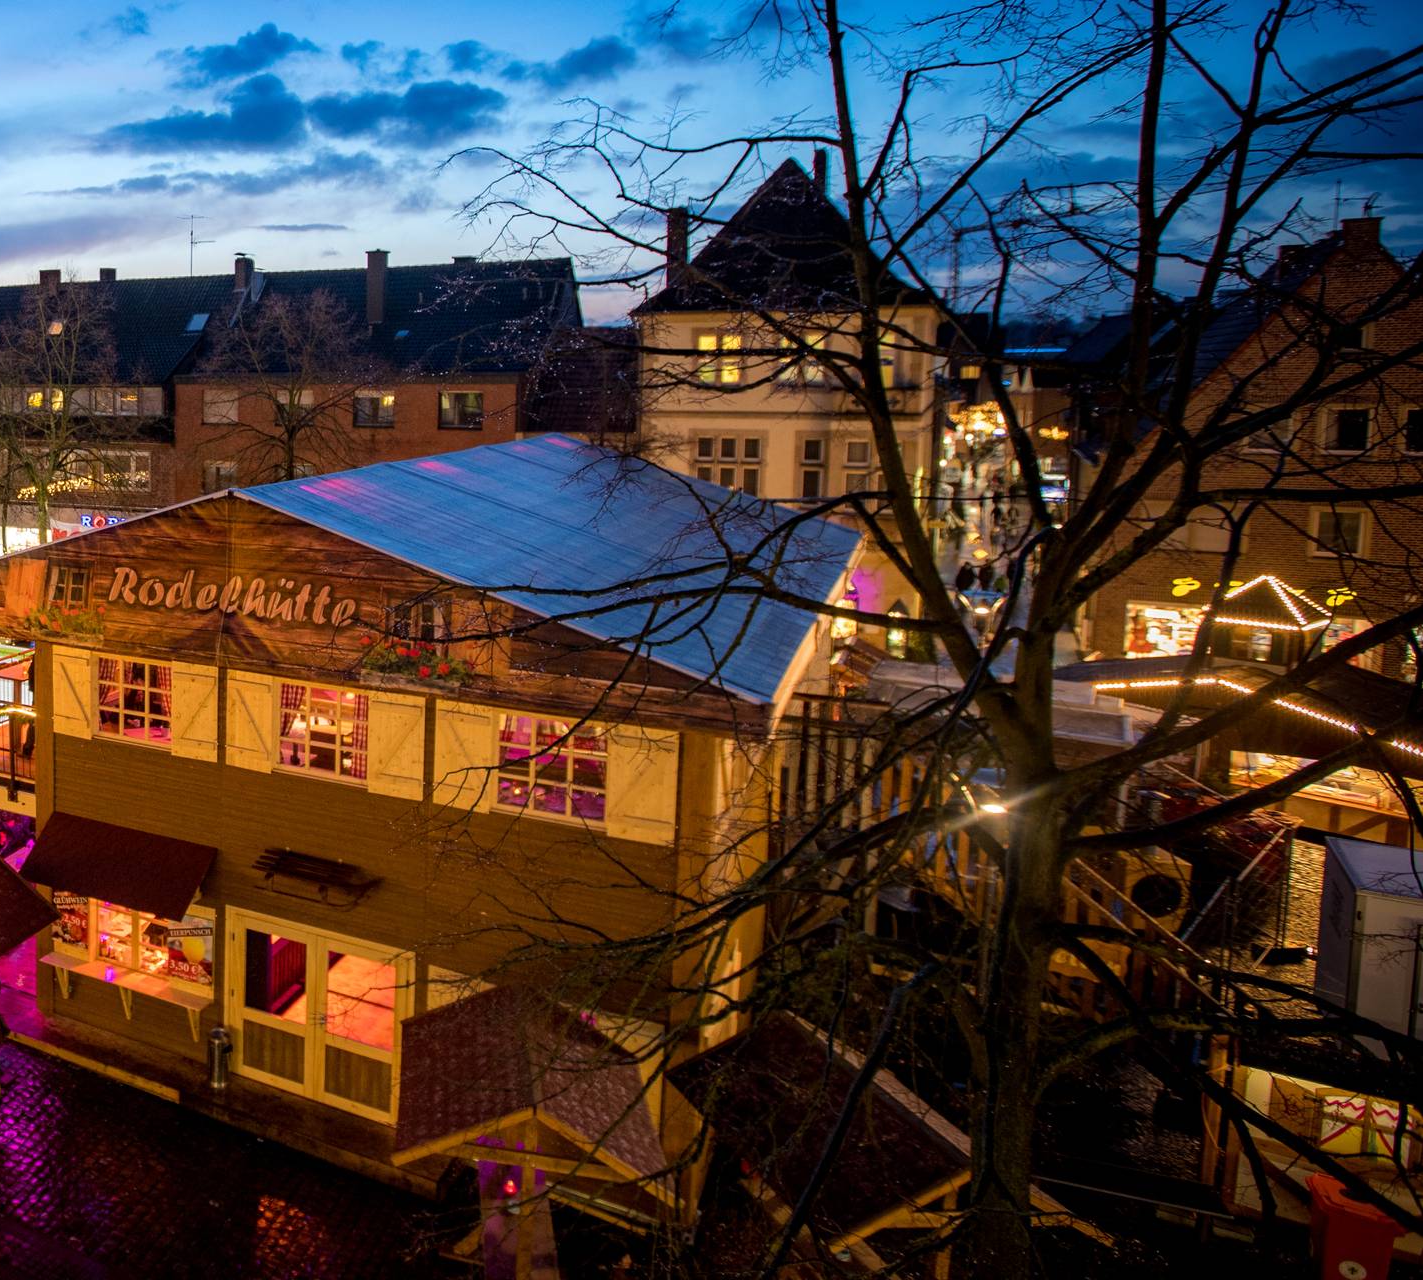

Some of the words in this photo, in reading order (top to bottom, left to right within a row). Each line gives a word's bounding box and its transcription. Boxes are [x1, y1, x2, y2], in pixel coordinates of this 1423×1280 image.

[108, 566, 357, 627] Rodelhütte
[53, 894, 88, 905] GLÜHWEIN
[63, 914, 80, 926] 2,50
[81, 919, 88, 929] €
[169, 959, 190, 973] 3,50
[191, 964, 198, 974] €
